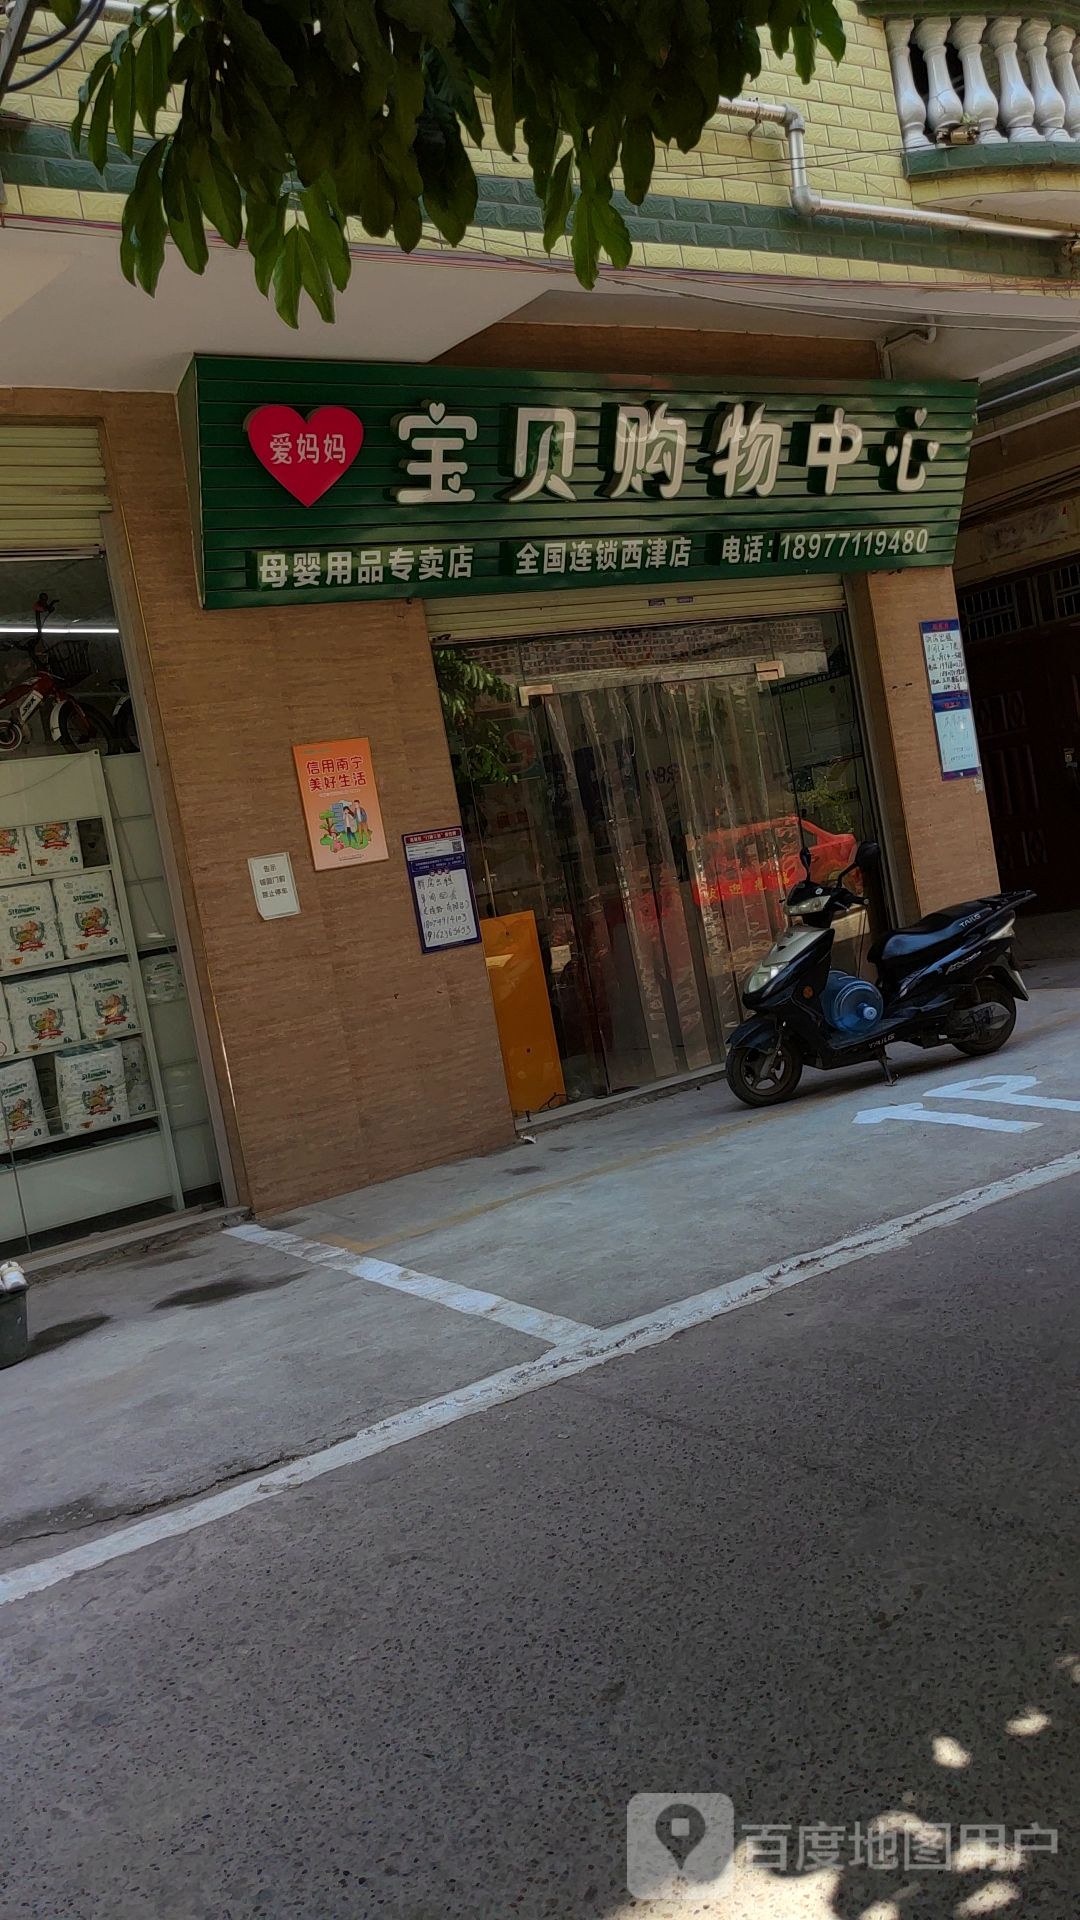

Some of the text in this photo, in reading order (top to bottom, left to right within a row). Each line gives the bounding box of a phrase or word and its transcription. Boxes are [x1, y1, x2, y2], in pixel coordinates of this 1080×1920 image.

[269, 433, 346, 465] 爱妈妈
[397, 401, 939, 502] 宝贝购物中心
[259, 545, 474, 588] 母婴用品专卖店
[515, 536, 692, 575] 全国连锁西津店
[306, 756, 364, 775] 信用南宁
[309, 772, 367, 791] 美好生活
